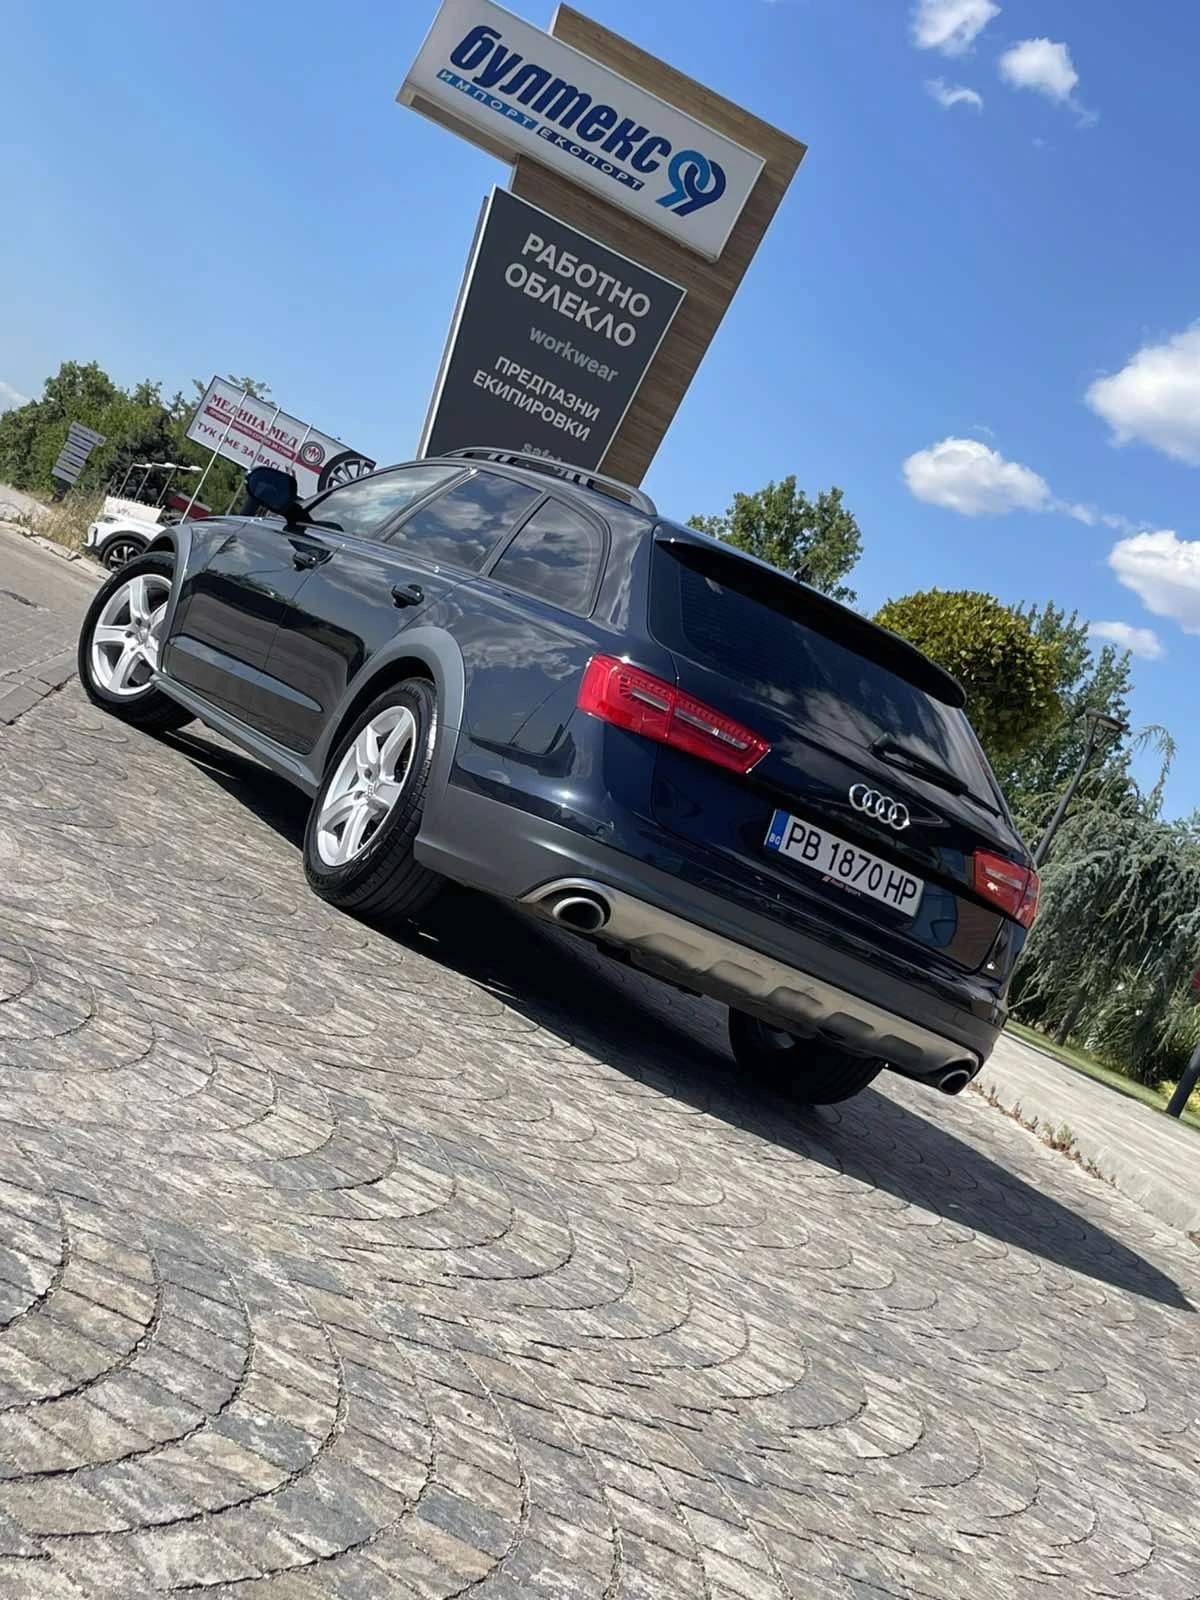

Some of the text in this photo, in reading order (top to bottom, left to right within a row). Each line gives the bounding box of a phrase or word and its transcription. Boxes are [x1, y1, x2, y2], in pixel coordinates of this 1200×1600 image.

[439, 70, 534, 129] ИМПОРТ
[504, 262, 637, 347] ОБЛЕКЛО
[521, 232, 651, 318] РАБОТНО
[494, 355, 601, 423] ПРЕДПАЗНИ
[529, 326, 619, 384] workwear
[472, 369, 592, 442] ЕКИПИРОВКИ
[197, 421, 217, 438] ТУК
[241, 444, 255, 460] ЗА
[769, 832, 781, 846] BG
[785, 823, 822, 862] PB
[830, 843, 884, 892] 1870
[883, 870, 918, 906] HP
